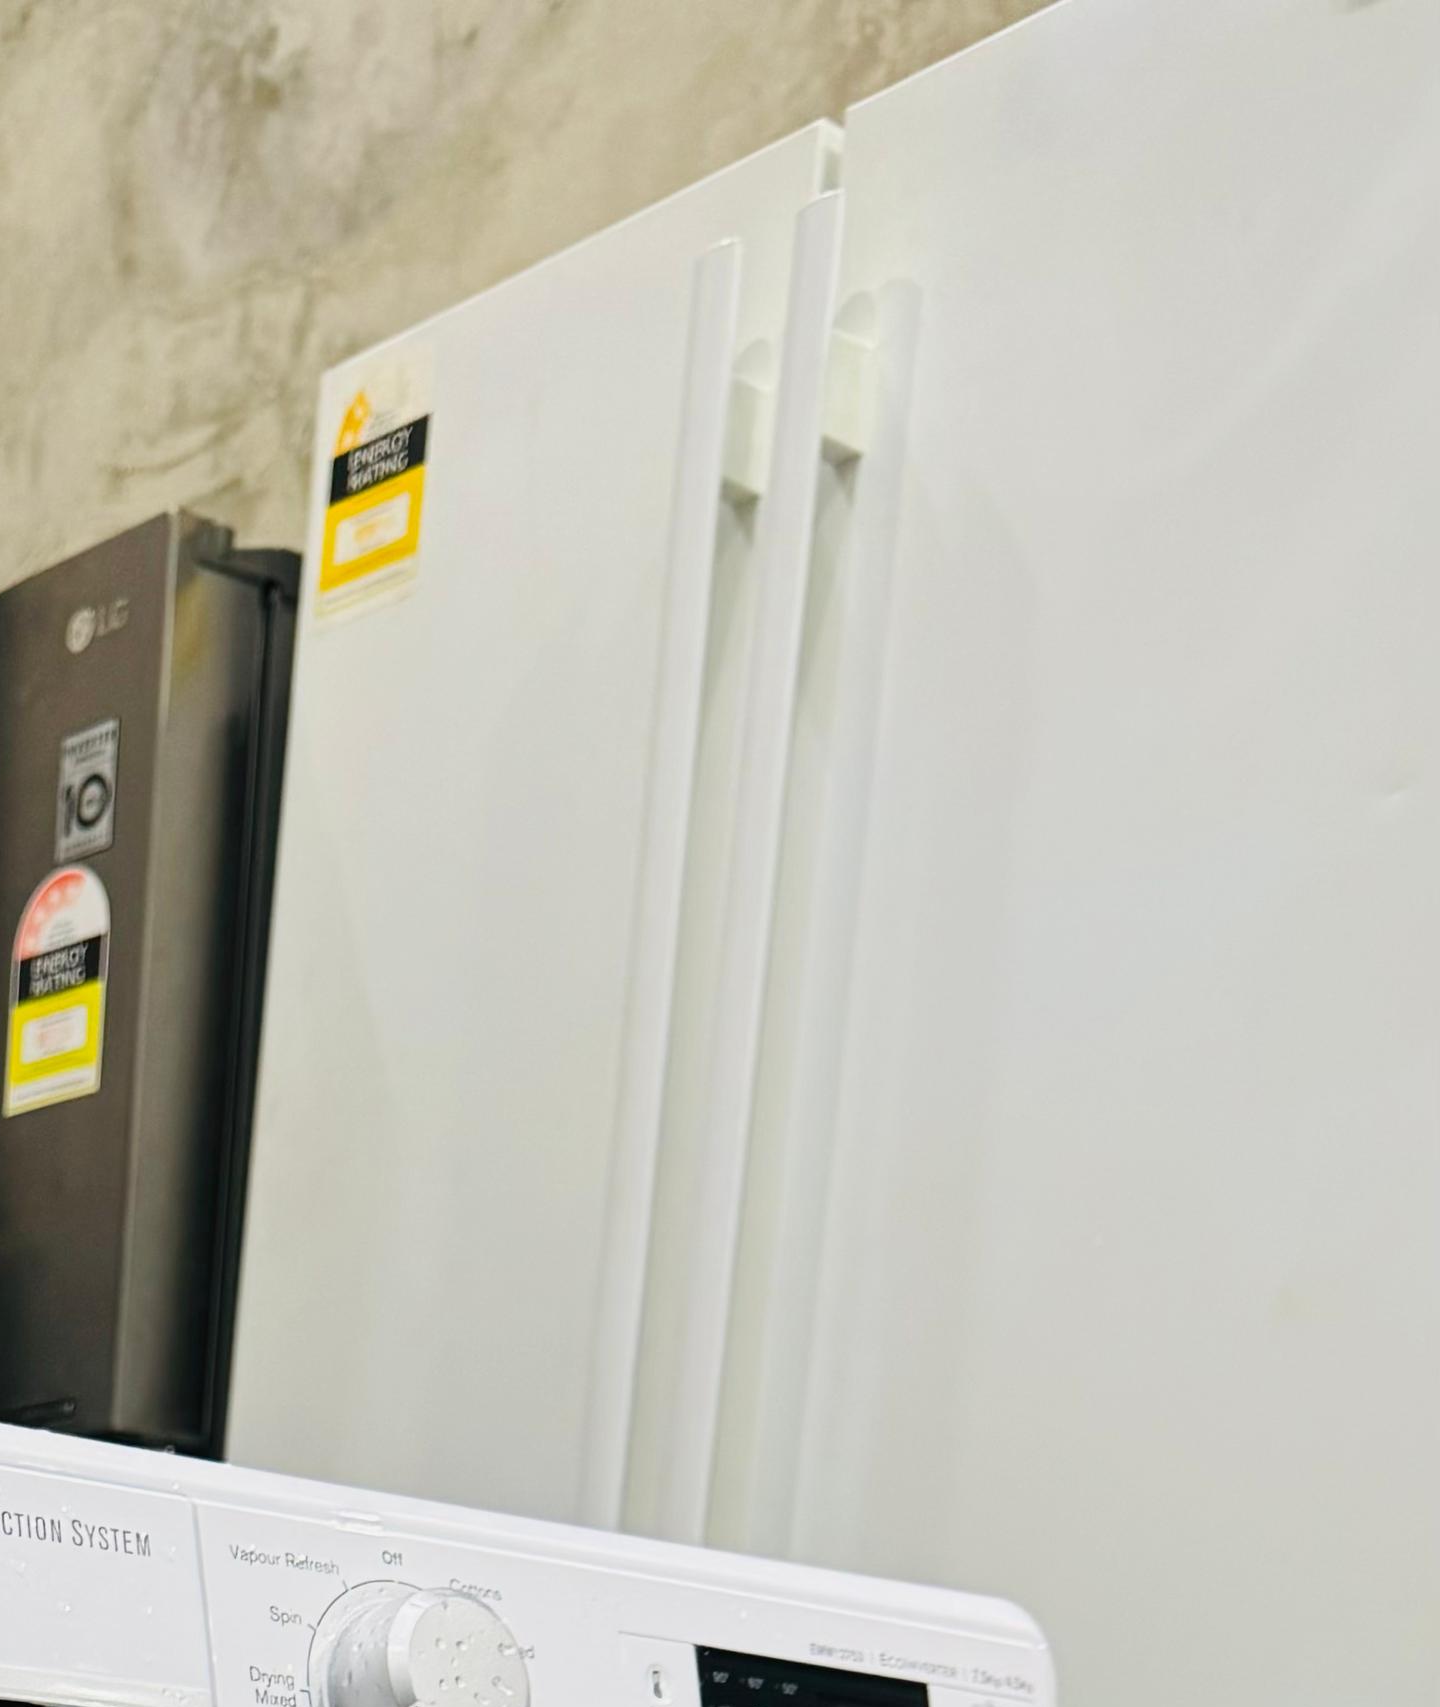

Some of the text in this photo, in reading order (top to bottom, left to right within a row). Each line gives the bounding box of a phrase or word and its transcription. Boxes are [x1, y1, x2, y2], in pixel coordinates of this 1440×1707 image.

[71, 1518, 152, 1558] SYSTEM
[229, 1544, 340, 1577] Vapour Refresh
[381, 1550, 404, 1567] Off
[270, 1606, 303, 1626] Spin
[249, 1666, 295, 1691] Drying
[255, 1688, 297, 1707] Mixed
